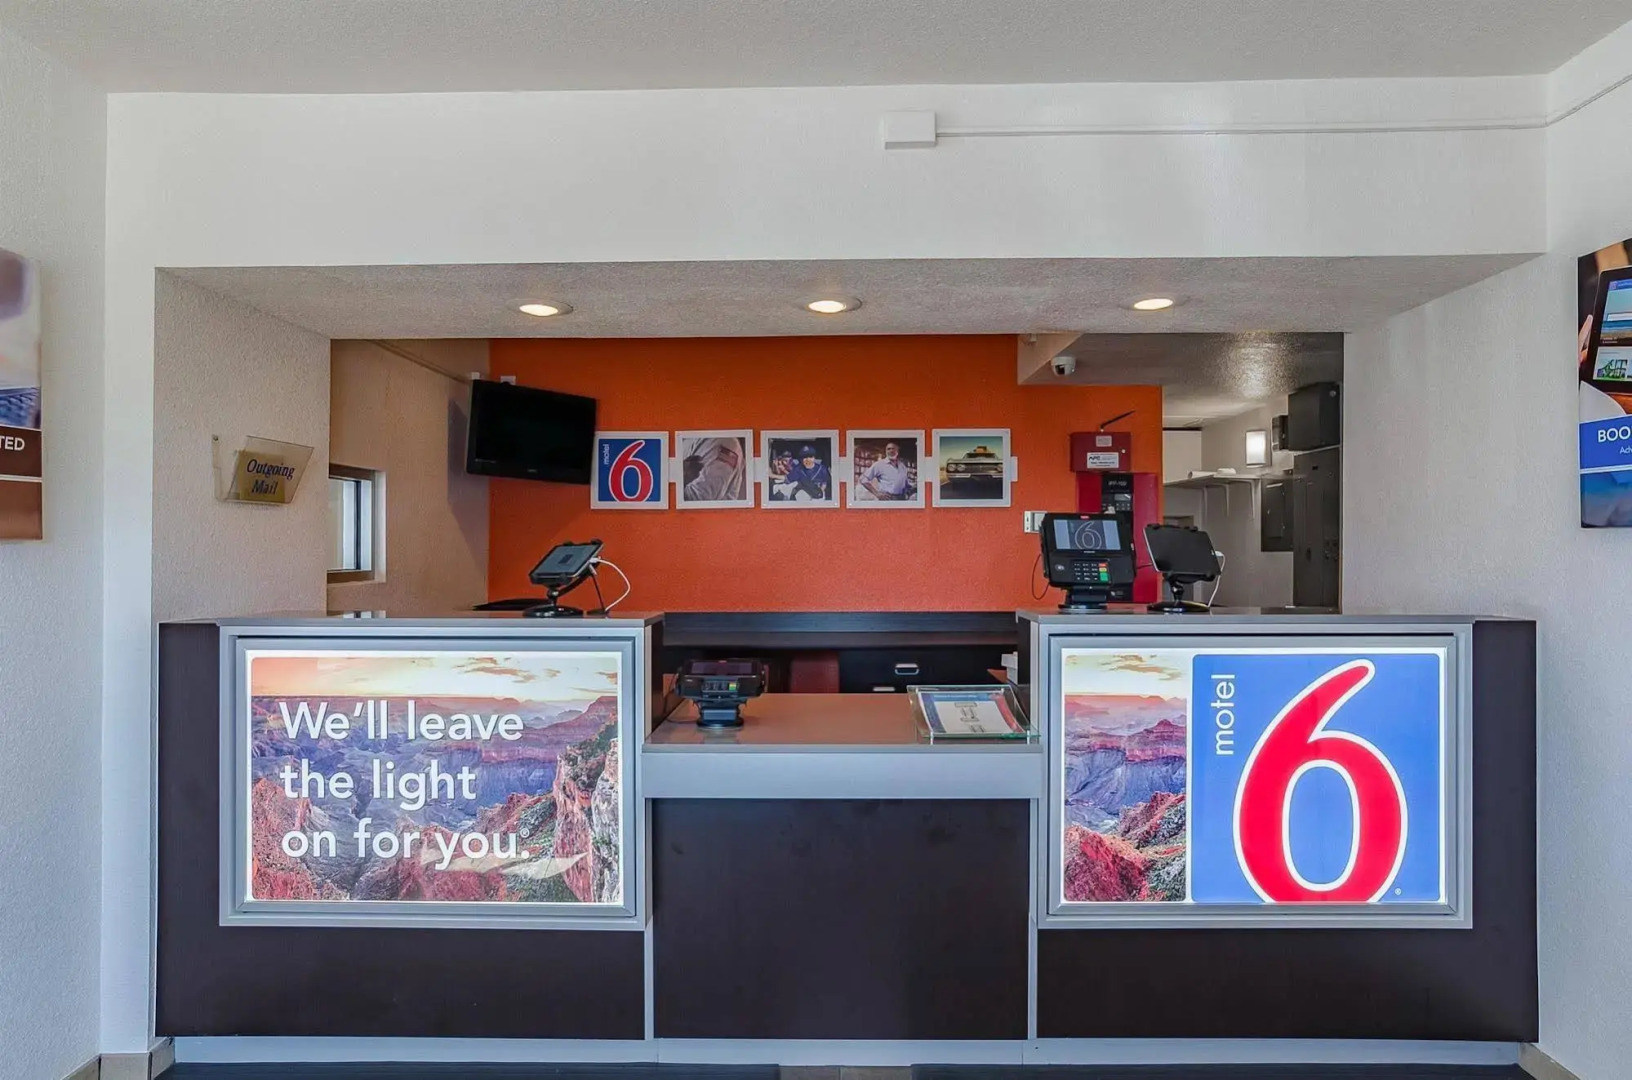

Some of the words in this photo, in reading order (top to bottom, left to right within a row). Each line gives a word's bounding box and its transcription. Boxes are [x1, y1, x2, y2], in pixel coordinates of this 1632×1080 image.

[602, 443, 610, 465] motel
[1597, 425, 1632, 443] BOO
[246, 458, 295, 480] Outgoing
[251, 480, 279, 495] Mail
[608, 439, 654, 502] 6
[406, 700, 525, 741] leave
[1210, 673, 1236, 756] motel
[279, 759, 355, 800] the
[372, 759, 477, 811] light
[1232, 658, 1409, 905] 6
[281, 828, 337, 859] on
[353, 818, 421, 858] for
